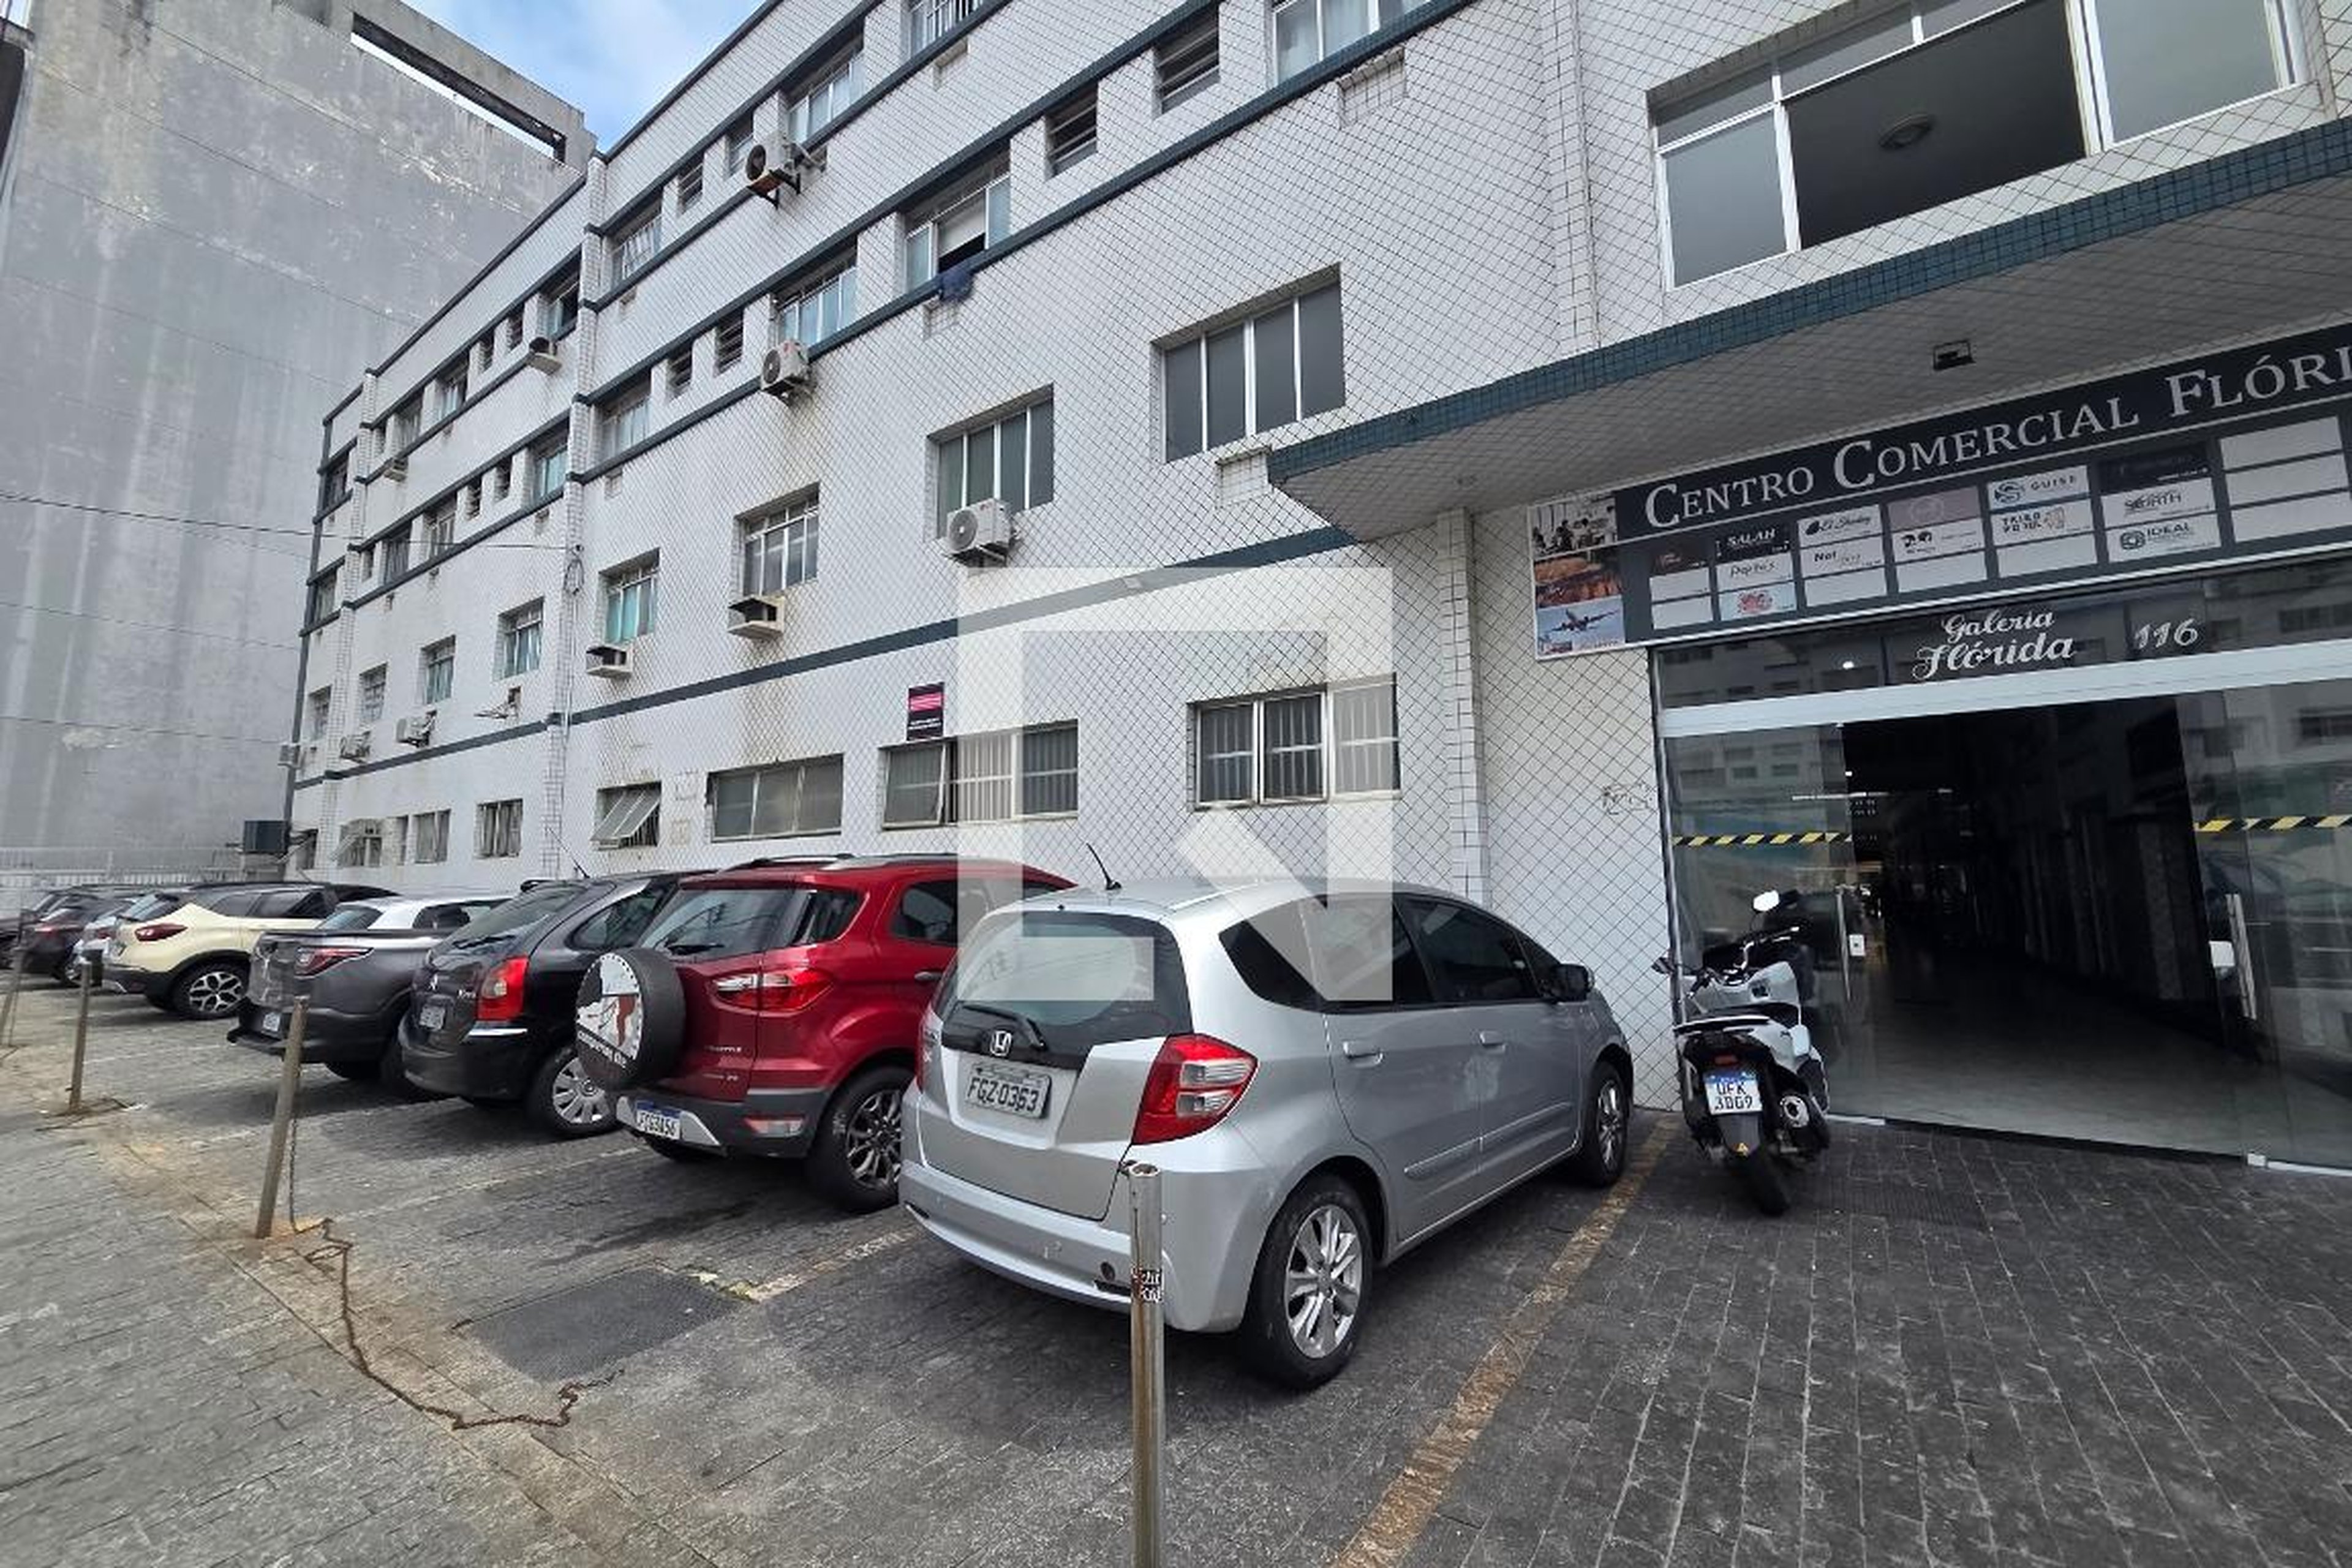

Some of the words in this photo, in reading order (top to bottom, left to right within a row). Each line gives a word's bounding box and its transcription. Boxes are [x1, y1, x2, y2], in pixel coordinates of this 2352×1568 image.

[1645, 467, 1814, 528] CENTRO
[1833, 397, 2139, 488] COMERCIAL
[1942, 609, 2056, 644] Galeria
[2134, 618, 2199, 649] 116
[1912, 633, 2078, 679] Flórida
